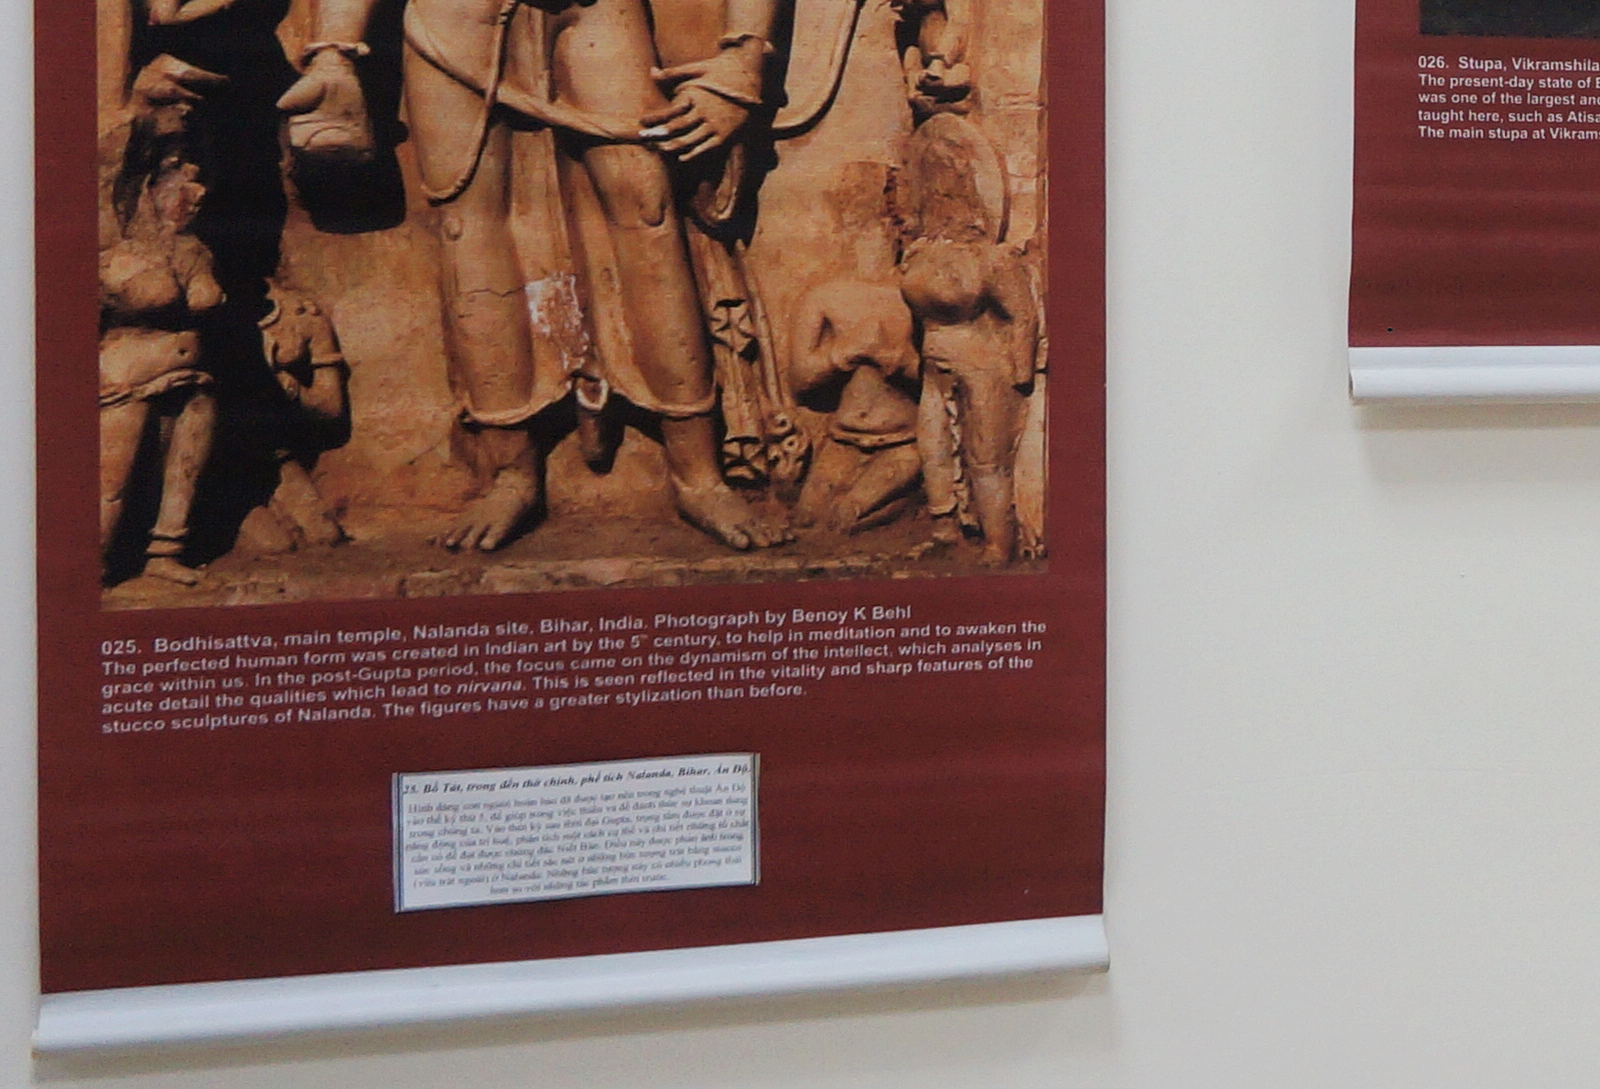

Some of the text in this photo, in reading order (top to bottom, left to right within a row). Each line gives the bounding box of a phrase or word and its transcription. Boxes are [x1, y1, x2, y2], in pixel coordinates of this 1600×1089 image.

[1418, 55, 1448, 68] 026.
[1458, 56, 1506, 71] Stupa,
[1511, 57, 1599, 71] Vikramshila
[1418, 93, 1446, 103] was
[1451, 93, 1477, 103] one
[1482, 91, 1496, 104] of
[1500, 92, 1522, 104] the
[1527, 92, 1574, 107] largest
[1418, 125, 1444, 138] The
[1449, 127, 1483, 138] main
[1488, 128, 1527, 141] stupa
[1532, 128, 1545, 139] at
[101, 639, 141, 655] 025.
[284, 631, 330, 645] main
[337, 627, 406, 643] temple,
[413, 623, 489, 639] Nalanda
[540, 619, 593, 633] Bihar,
[654, 611, 759, 628] Photograph
[765, 610, 786, 626] by
[792, 608, 847, 624] Benoy
[853, 606, 866, 620] K
[872, 605, 910, 619] Behl
[101, 656, 1033, 714] acute detail the qualities which lead to nirvana. This is seen reflected in the vitality and sharp features of the
[102, 719, 165, 733] stucco
[171, 714, 268, 730] sculptures
[274, 708, 292, 722] of
[382, 702, 414, 716] The
[420, 701, 481, 716] figures
[487, 698, 528, 710] have
[534, 698, 543, 708] a
[549, 693, 610, 709] greater
[615, 689, 701, 705] stylization
[707, 686, 744, 699] than
[749, 683, 806, 697] before.
